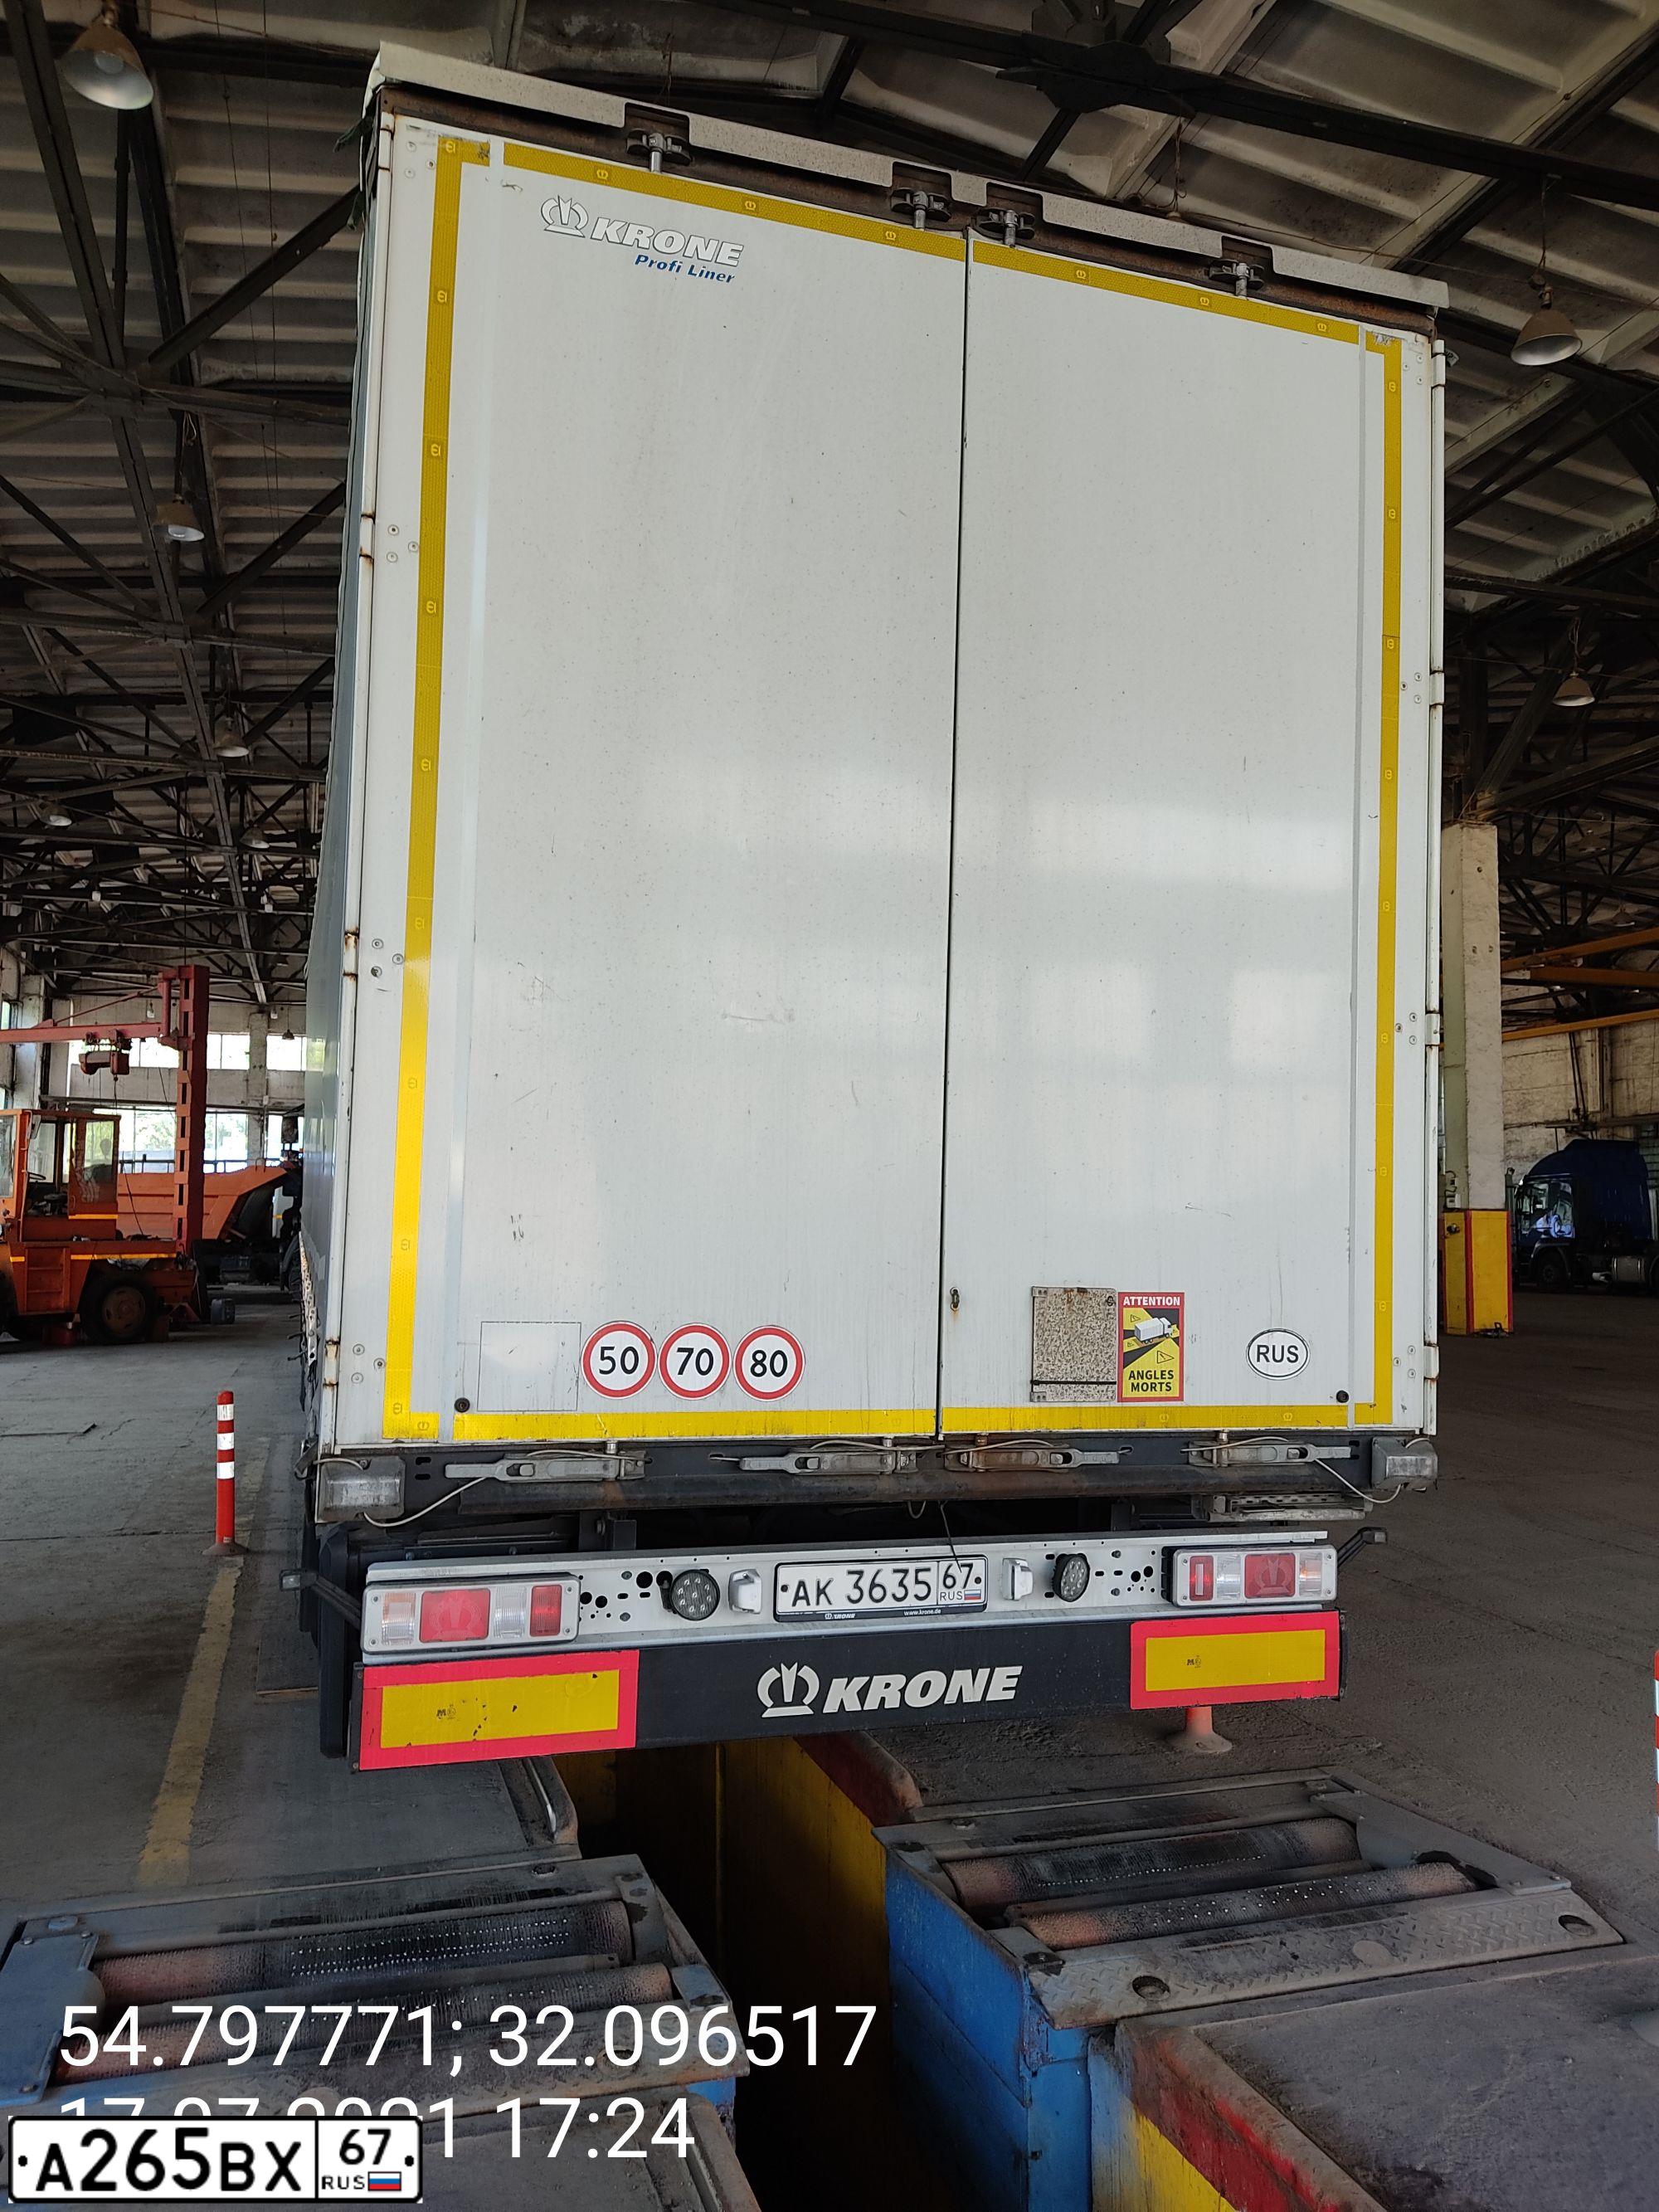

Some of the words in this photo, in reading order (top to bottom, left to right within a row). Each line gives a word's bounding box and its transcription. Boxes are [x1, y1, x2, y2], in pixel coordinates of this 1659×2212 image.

[591, 217, 744, 266] KRONE
[635, 254, 683, 273] Profi
[687, 265, 735, 284] Liner
[1122, 1295, 1180, 1306] ATTENTION
[598, 1346, 640, 1375] 50
[676, 1347, 714, 1376] 70
[750, 1349, 788, 1377] 80
[1256, 1344, 1299, 1363] RUS
[1128, 1370, 1174, 1381] ANGLES
[1131, 1381, 1172, 1392] MORTS
[846, 1567, 932, 1604] 3635
[942, 1562, 975, 1590] 67
[940, 1590, 963, 1601] RUS
[822, 1666, 1023, 1714] KRONE
